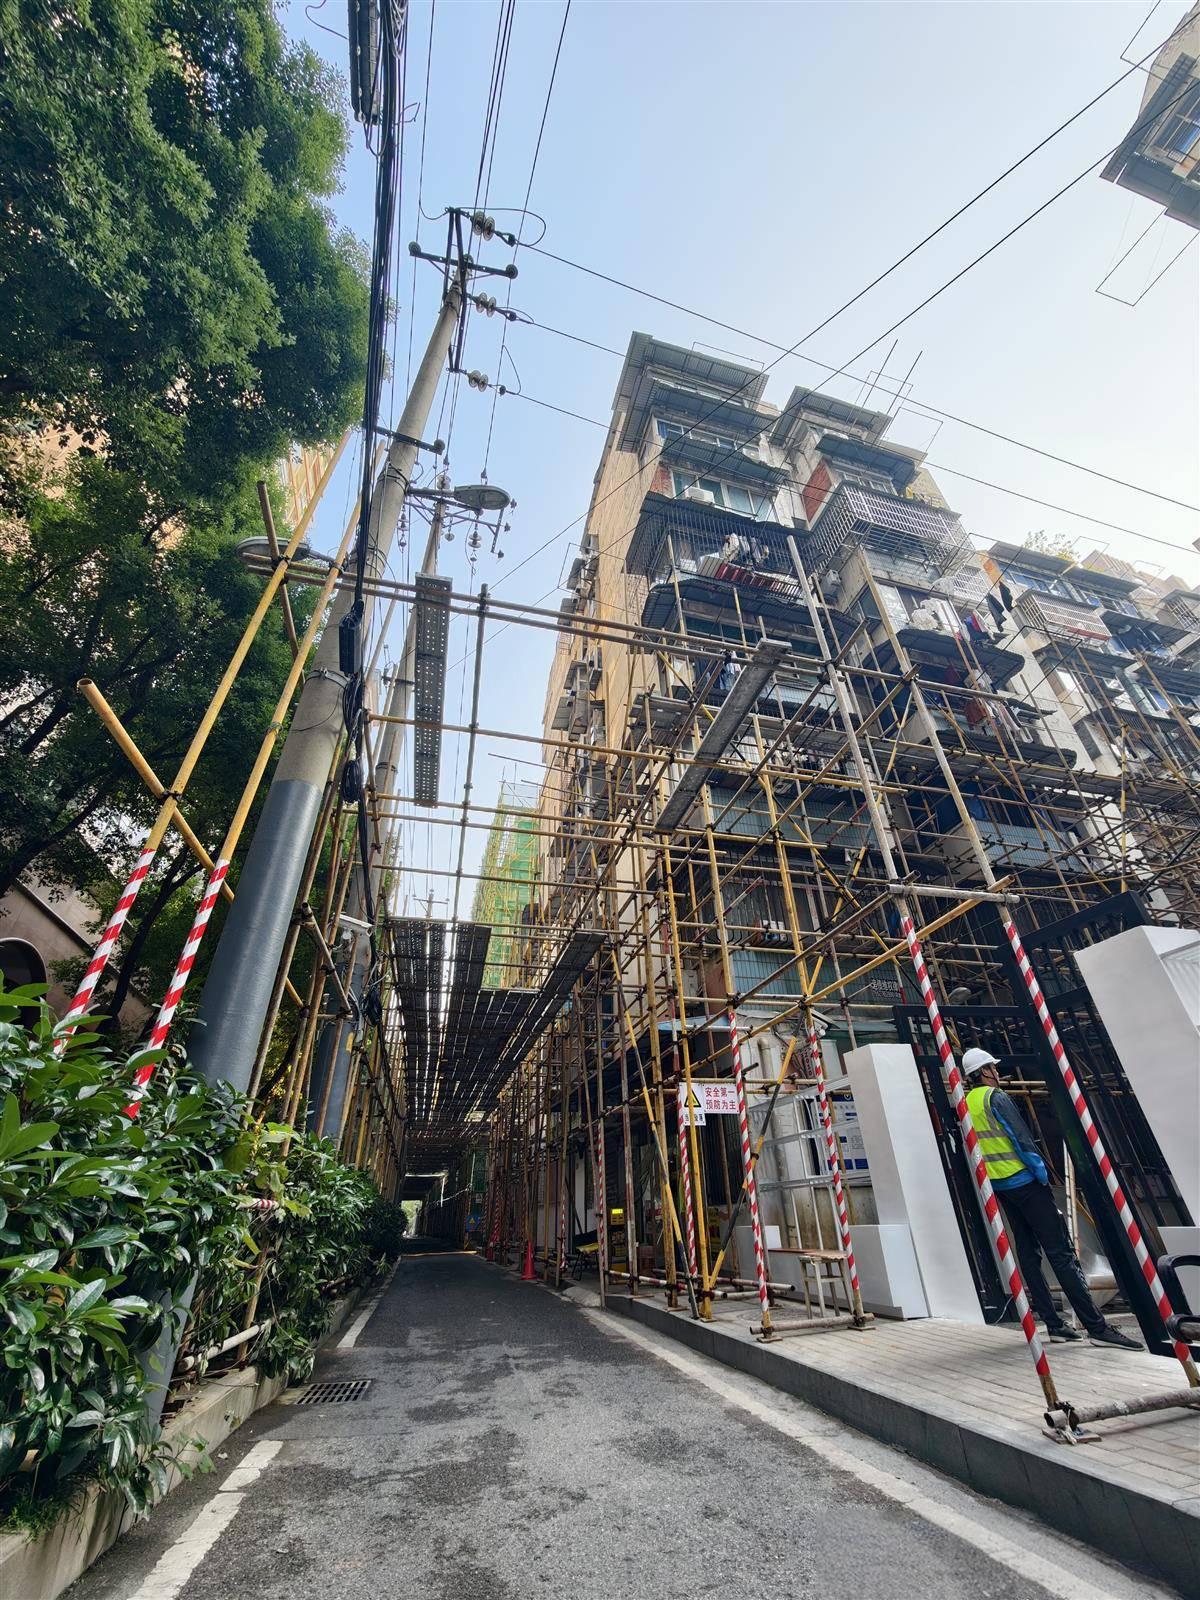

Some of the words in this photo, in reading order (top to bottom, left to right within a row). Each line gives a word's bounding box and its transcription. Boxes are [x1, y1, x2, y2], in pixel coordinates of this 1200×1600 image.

[705, 1087, 735, 1097] 安全第一
[706, 1100, 736, 1110] 预防为主
